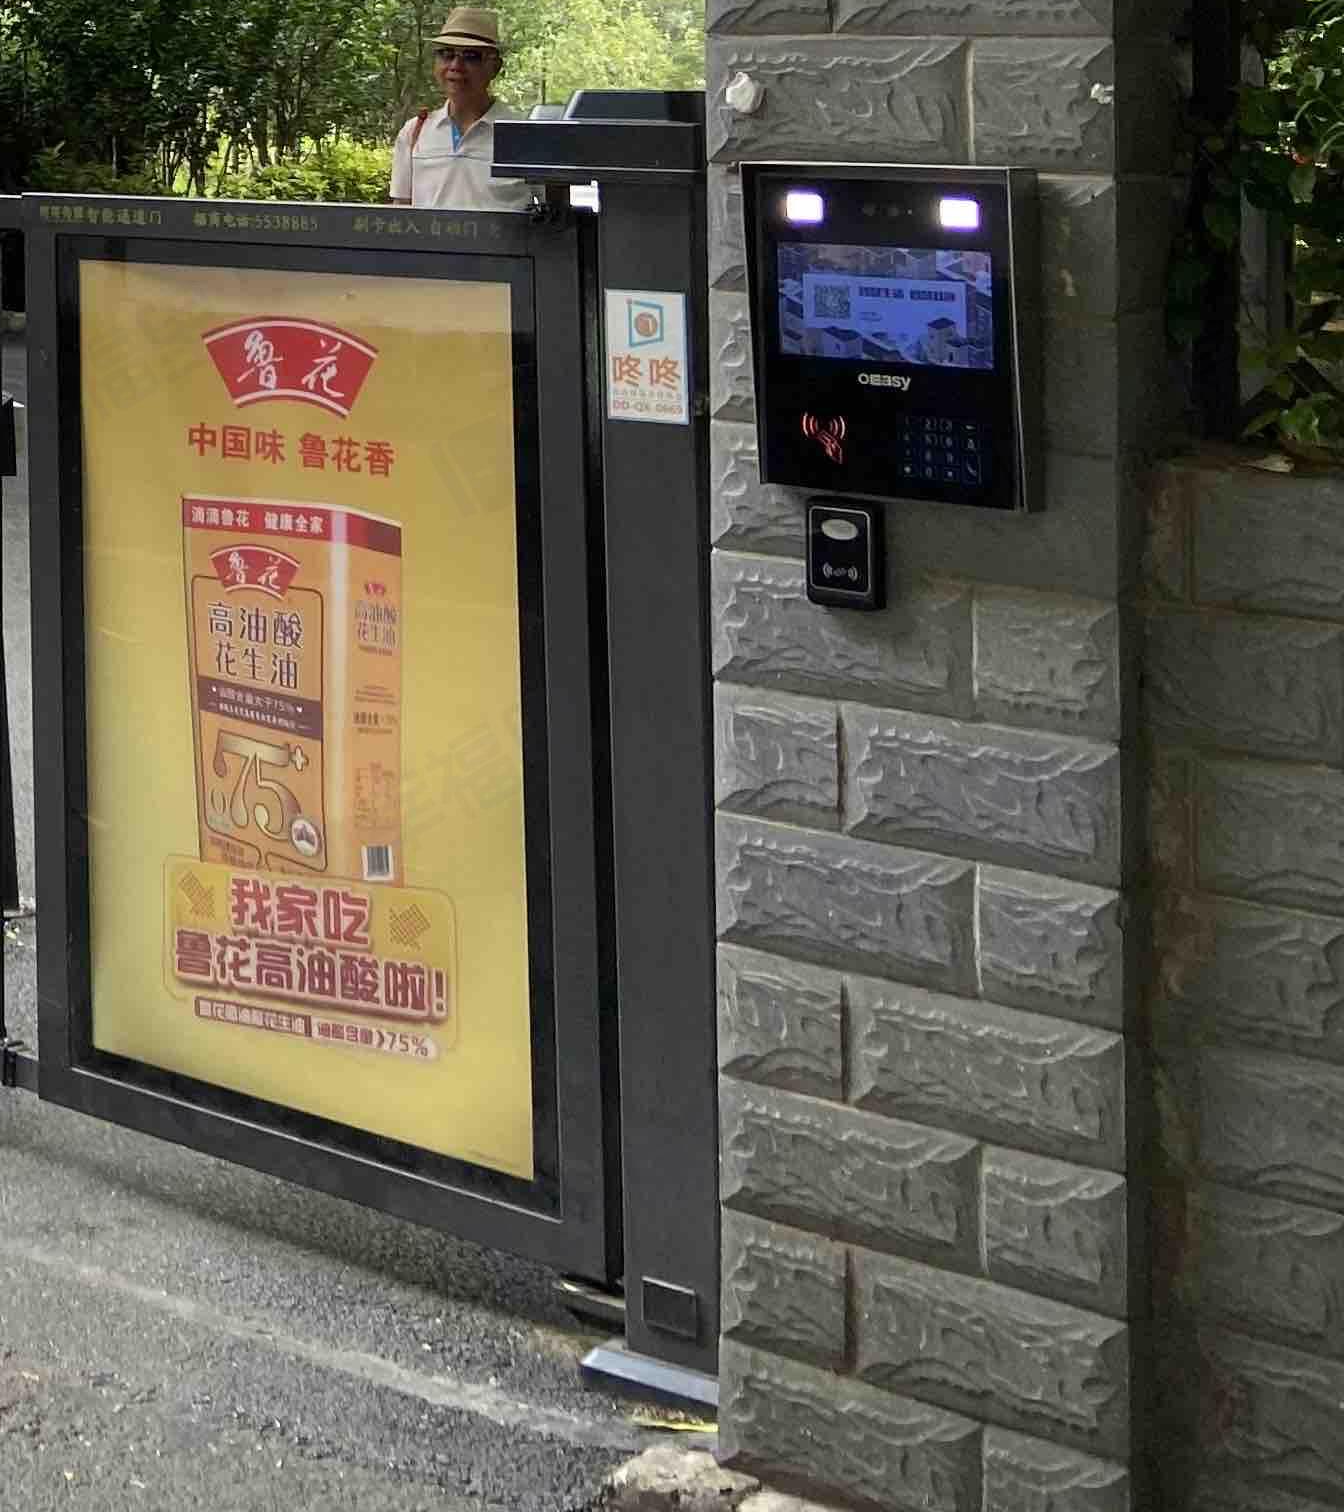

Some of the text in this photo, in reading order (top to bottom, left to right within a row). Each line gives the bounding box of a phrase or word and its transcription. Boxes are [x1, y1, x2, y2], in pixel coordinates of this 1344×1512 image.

[237, 330, 345, 397] 鲁花
[188, 422, 395, 477] 中国味 鲁花香
[208, 600, 304, 649] 高油酸
[215, 640, 299, 689] 花生油
[231, 877, 369, 945] 我家吃
